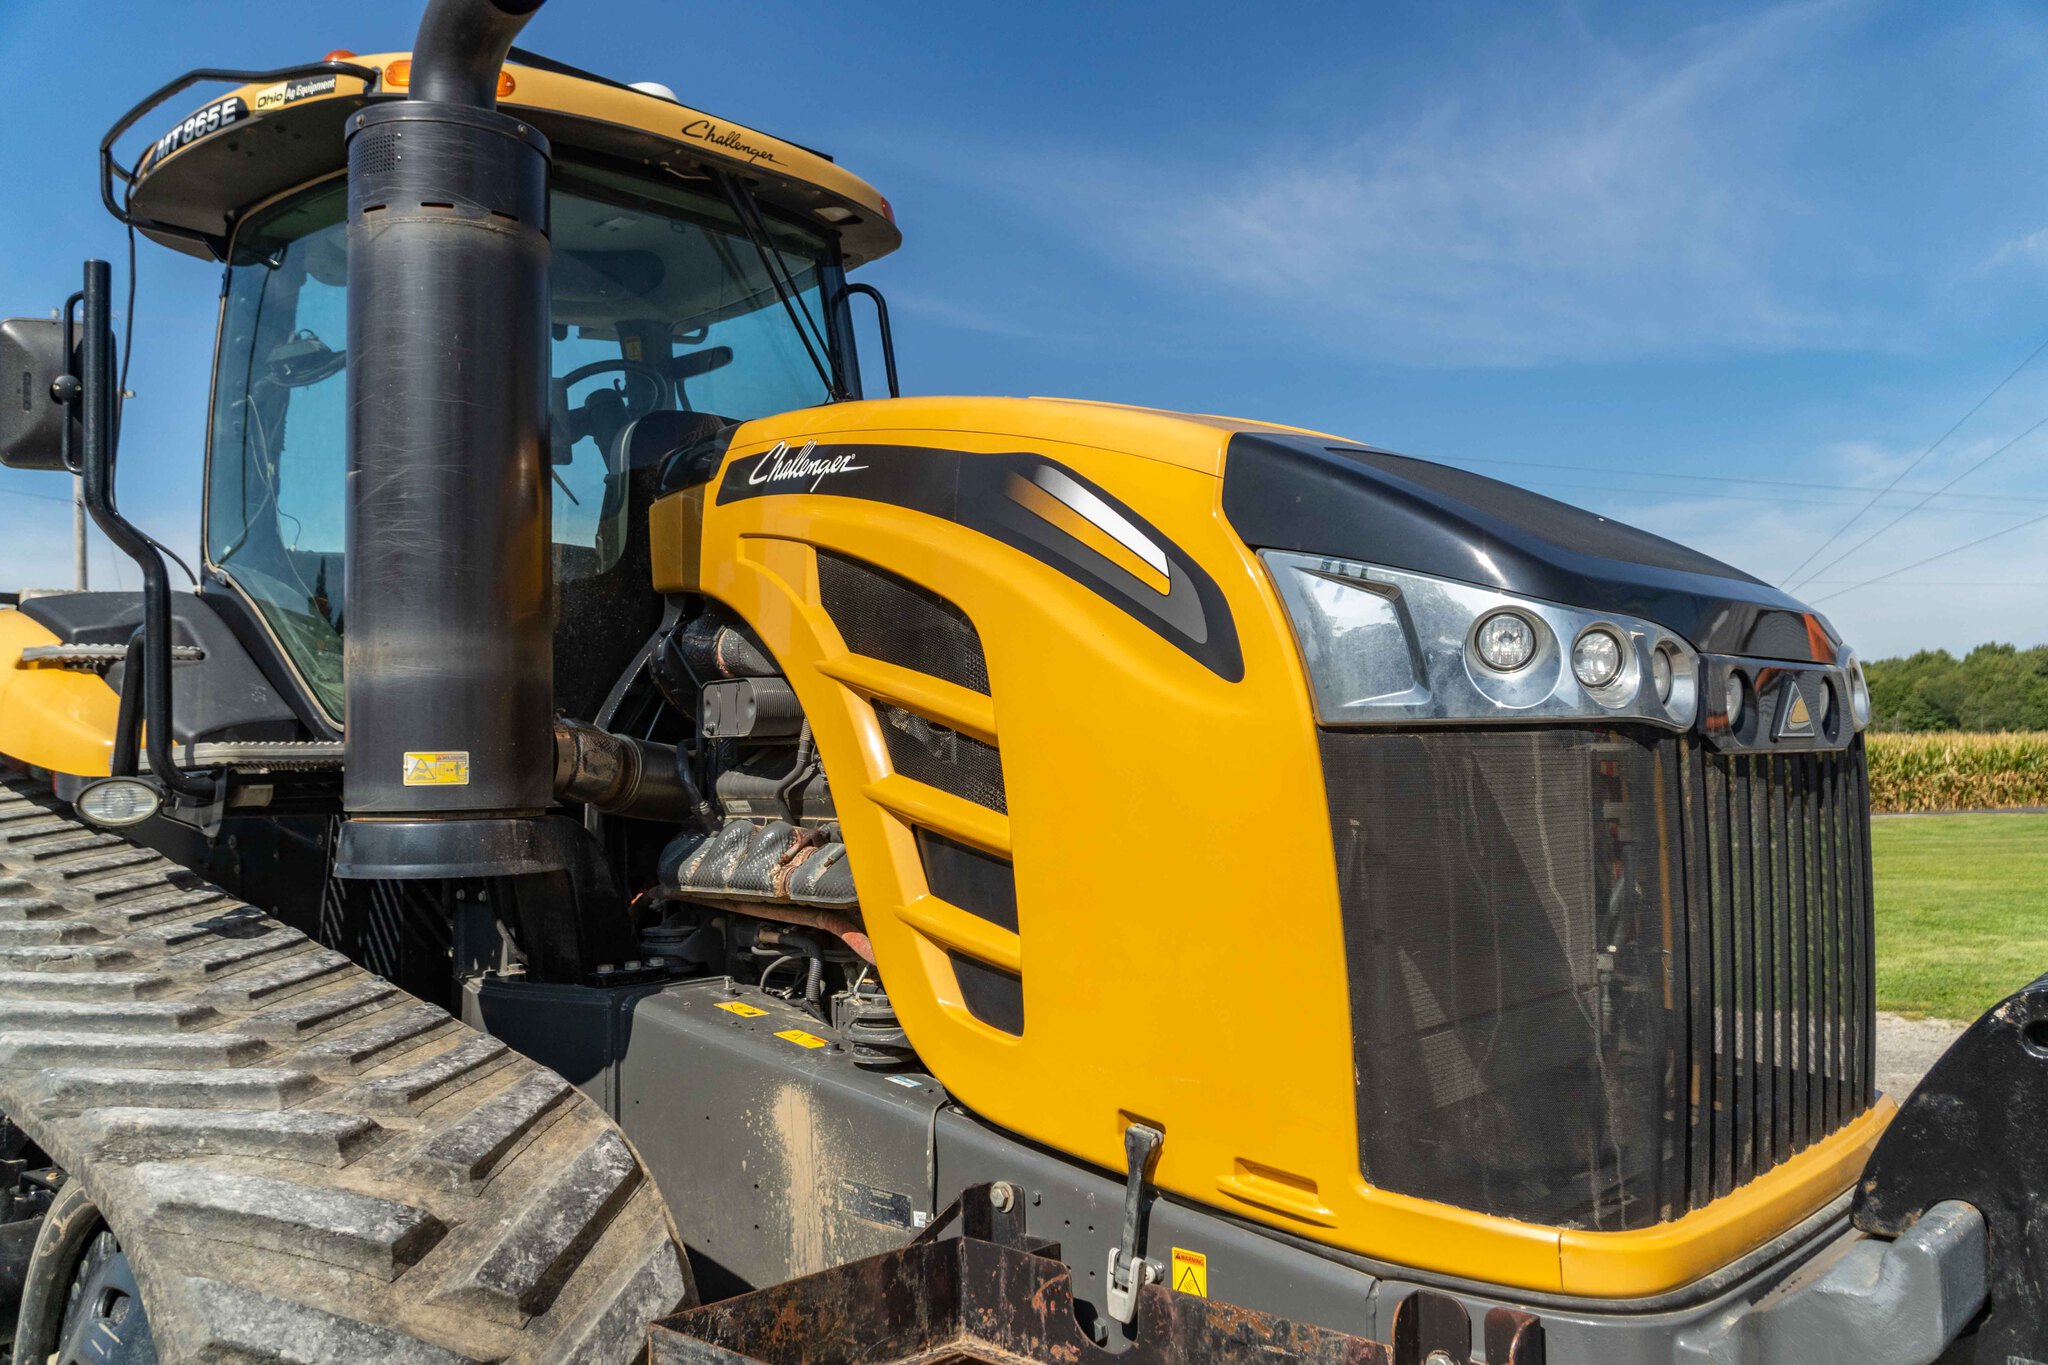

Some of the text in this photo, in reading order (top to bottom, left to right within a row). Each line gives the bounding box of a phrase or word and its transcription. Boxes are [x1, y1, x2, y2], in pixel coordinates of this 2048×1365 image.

[257, 78, 336, 108] Ohio Ag Equipment
[155, 97, 238, 162] MT865E
[681, 120, 789, 164] Challenger
